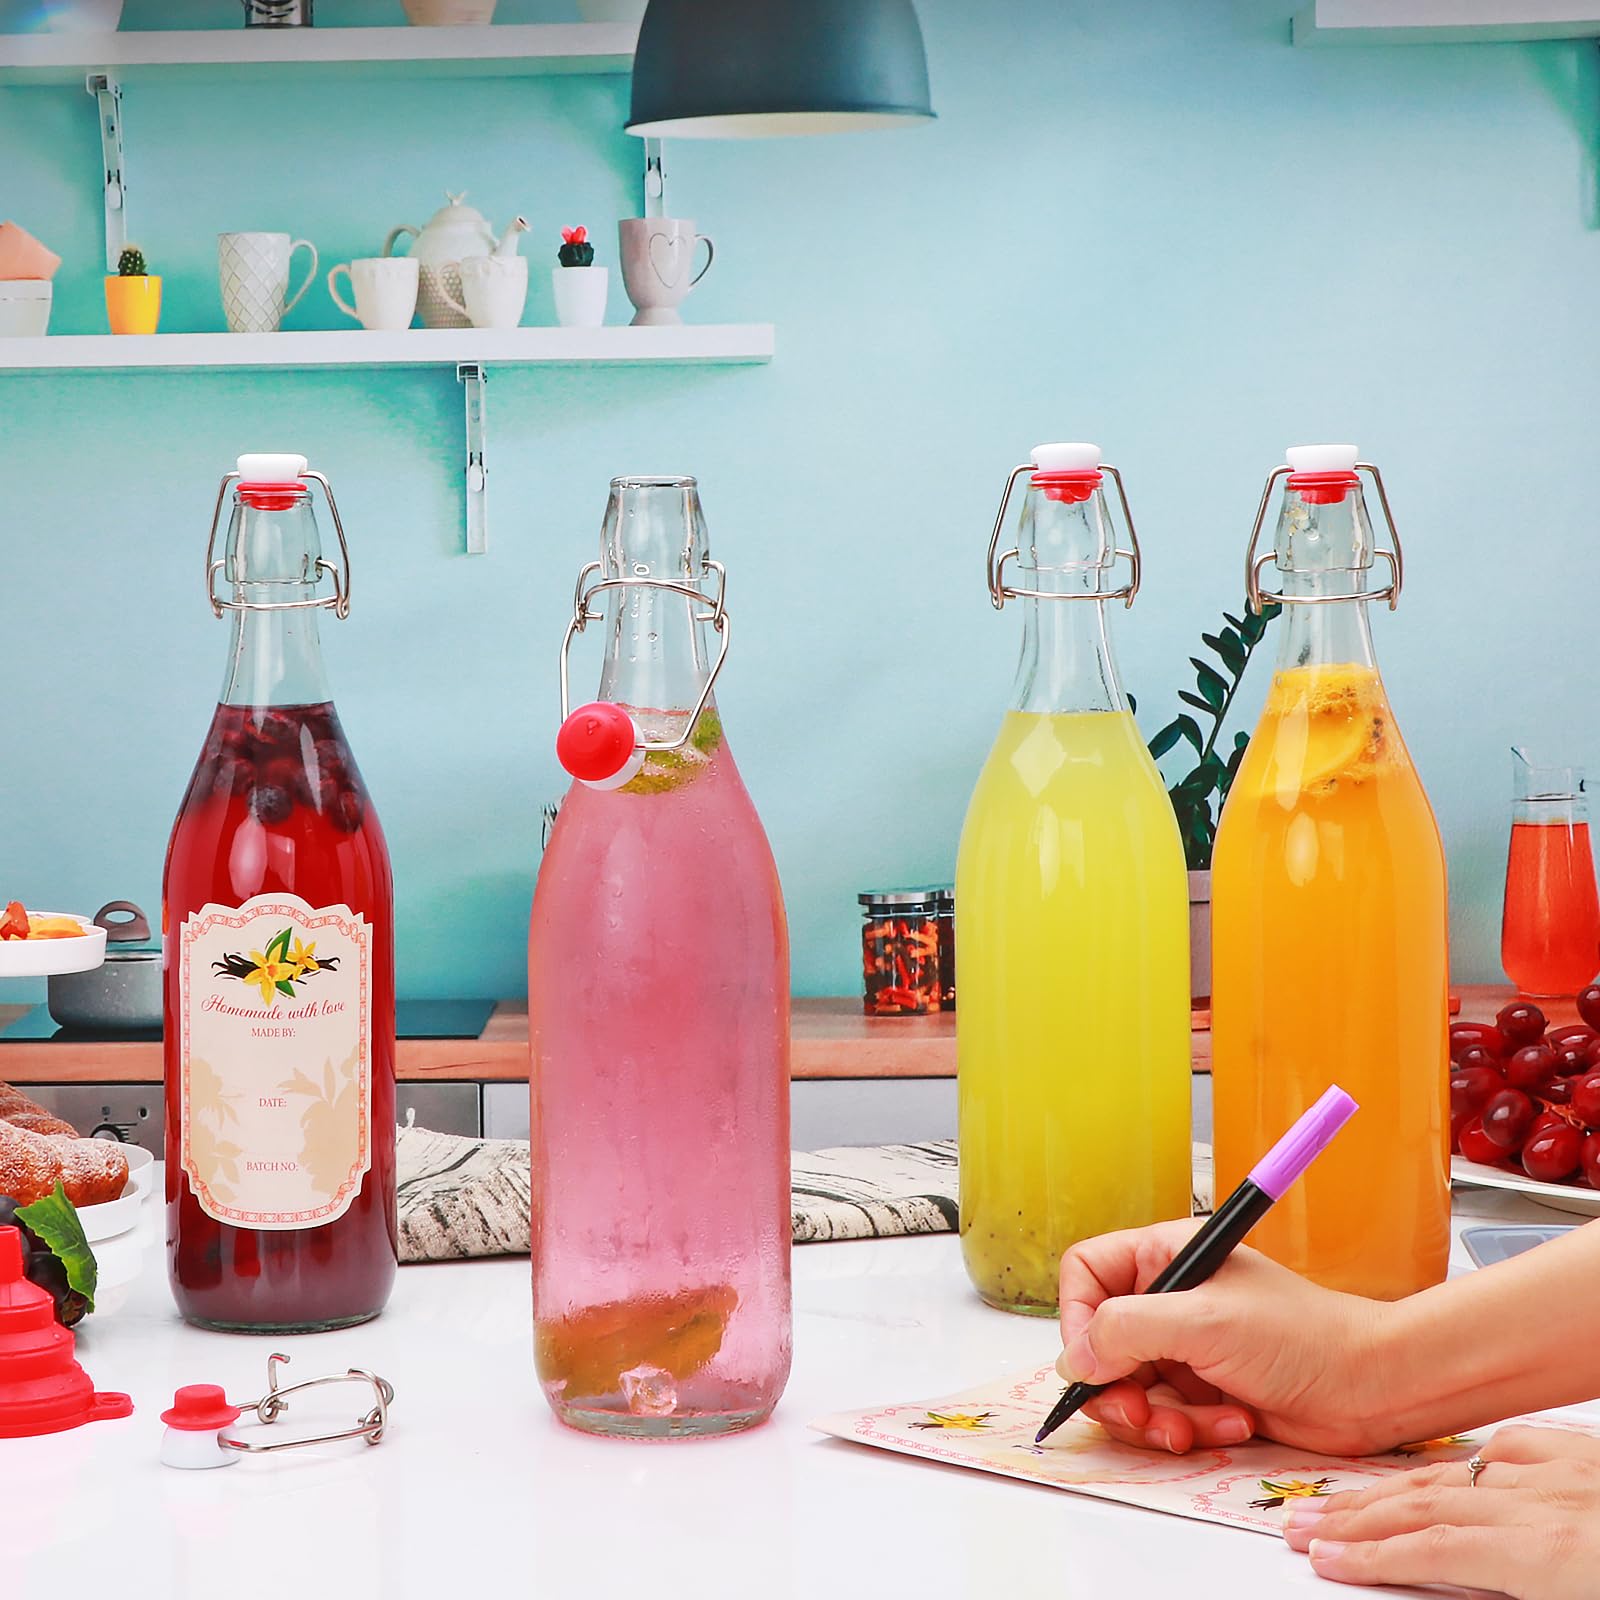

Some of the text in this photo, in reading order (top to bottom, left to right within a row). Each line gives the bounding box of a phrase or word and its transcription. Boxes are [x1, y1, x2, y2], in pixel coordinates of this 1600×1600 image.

[201, 993, 345, 1020] Homemade with love
[251, 1027, 297, 1038] MADE BY:
[259, 1097, 288, 1108] DATE:
[246, 1161, 299, 1172] BATCH NO:
